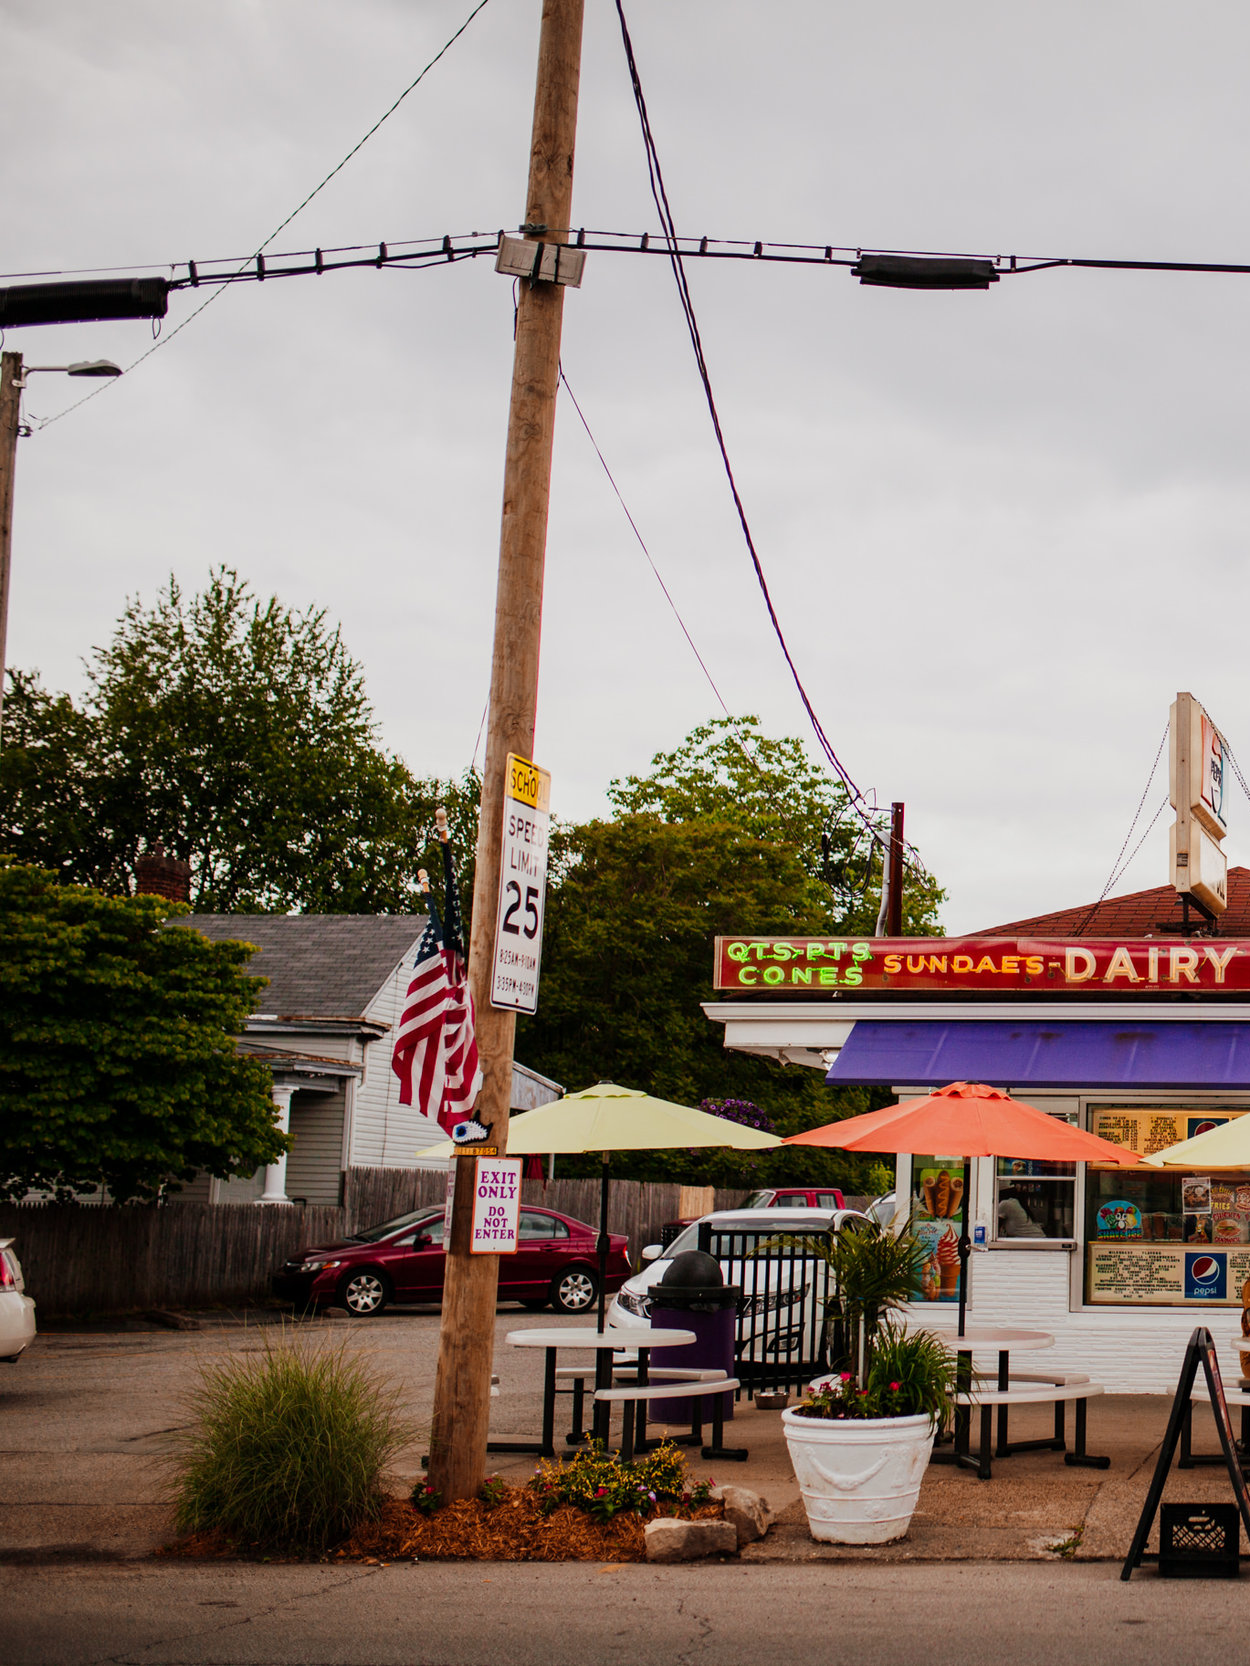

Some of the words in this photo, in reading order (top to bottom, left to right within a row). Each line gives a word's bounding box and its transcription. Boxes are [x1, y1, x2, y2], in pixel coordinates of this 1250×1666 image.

[1211, 757, 1222, 788] PEPS
[511, 768, 547, 804] SCHOOL
[509, 814, 544, 848] SPEED
[510, 846, 539, 877] LIMIT
[502, 880, 539, 940] 25
[738, 965, 863, 985] CONES
[481, 1171, 517, 1184] EXIT
[478, 1185, 517, 1199] ONLY
[488, 1206, 505, 1217] DO
[484, 1218, 508, 1228] NOT
[475, 1229, 515, 1240] ENTER
[1193, 1286, 1217, 1296] pepsi
